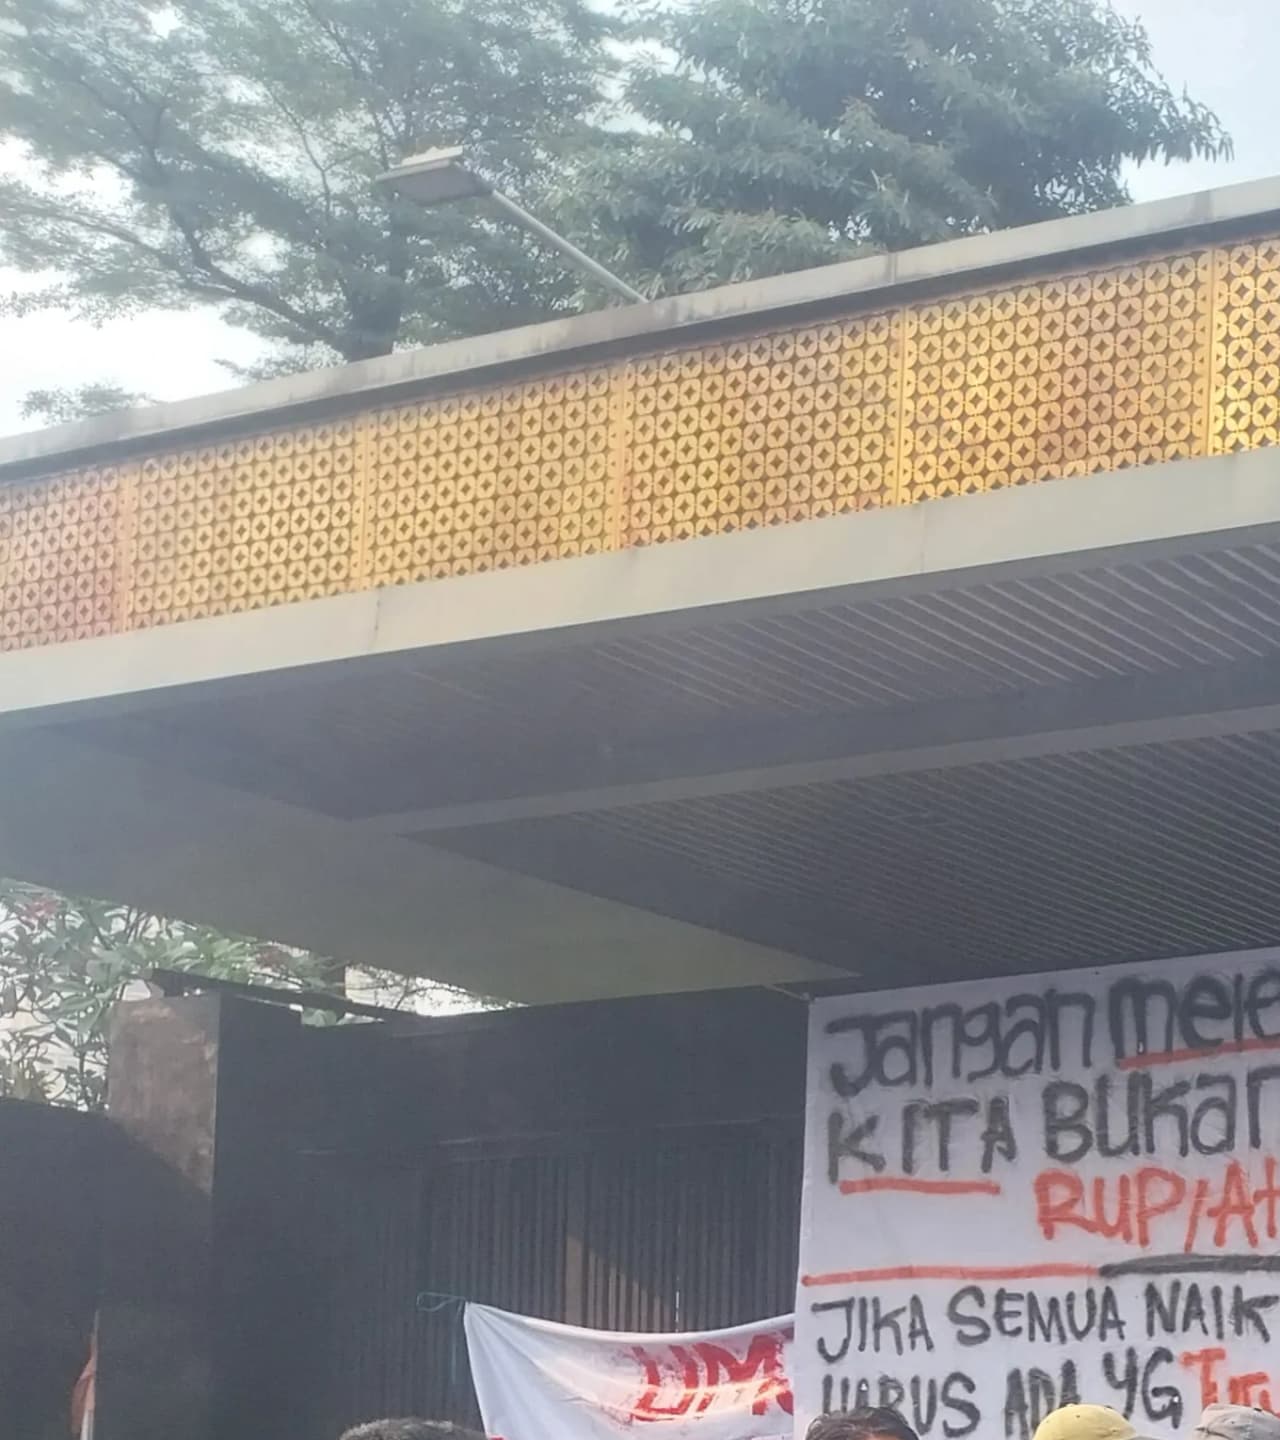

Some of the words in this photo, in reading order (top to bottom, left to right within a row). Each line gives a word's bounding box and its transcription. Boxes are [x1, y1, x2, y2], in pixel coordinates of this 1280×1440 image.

[827, 1094, 1016, 1184] KITA
[810, 1294, 935, 1365] JIKA
[947, 1284, 1127, 1347] SEMUA
[1144, 1284, 1280, 1344] NAIK
[1102, 1346, 1184, 1430] YG
